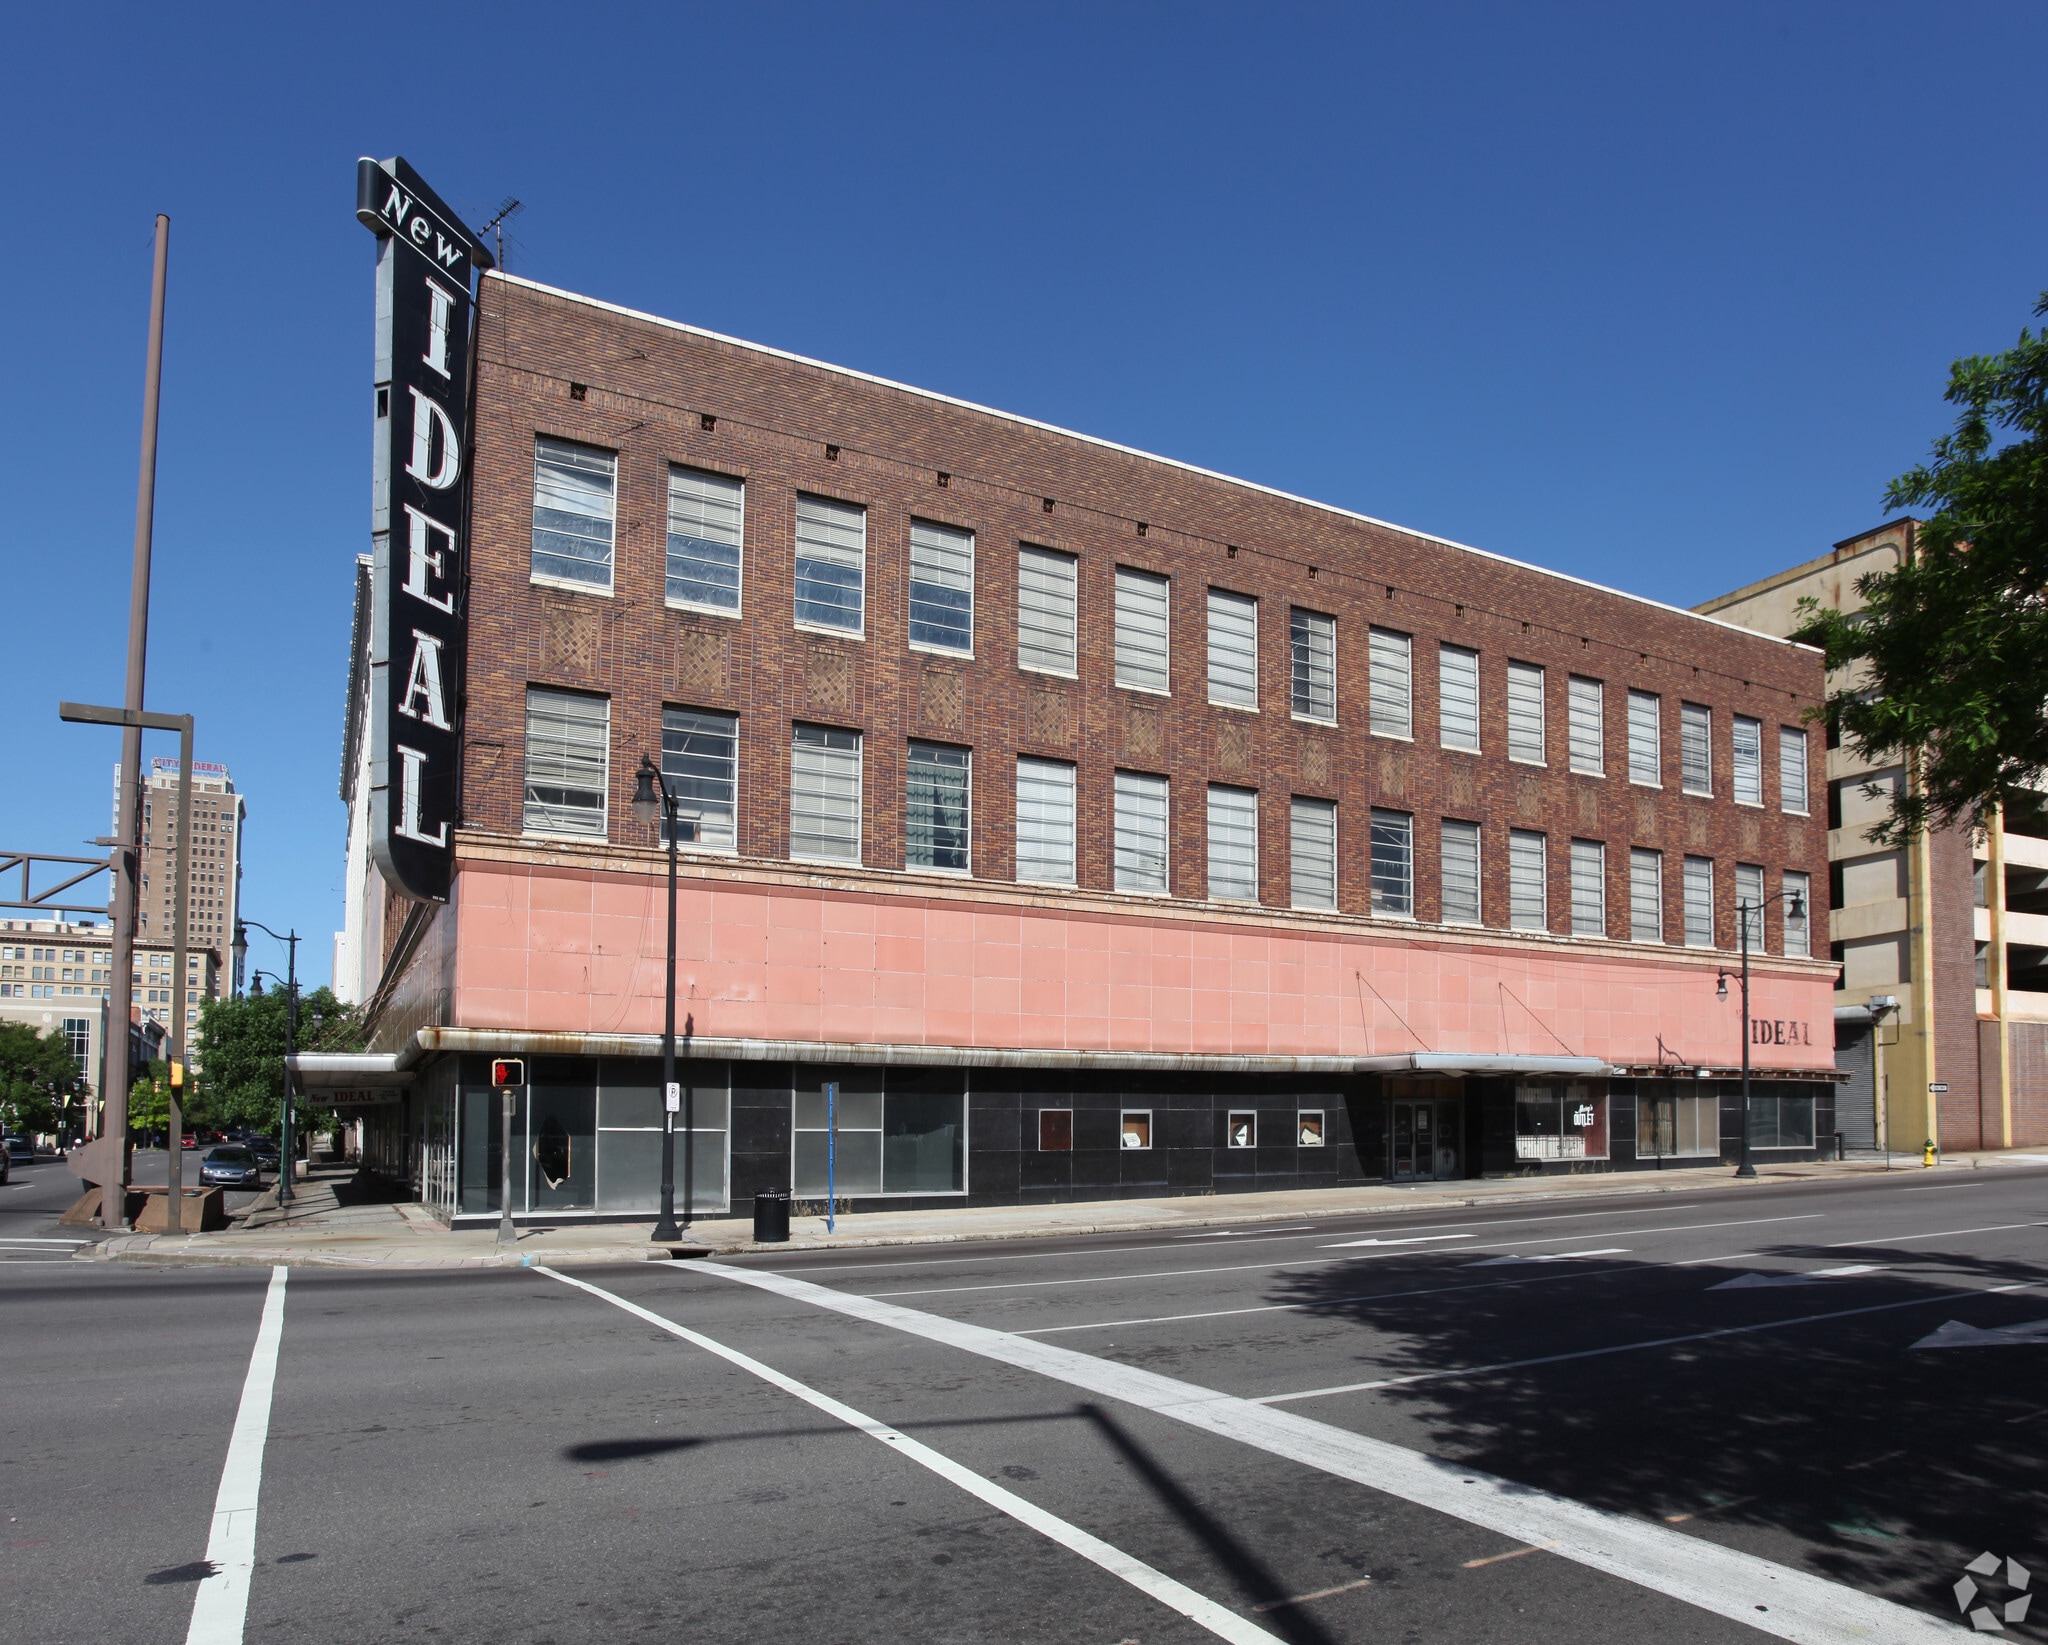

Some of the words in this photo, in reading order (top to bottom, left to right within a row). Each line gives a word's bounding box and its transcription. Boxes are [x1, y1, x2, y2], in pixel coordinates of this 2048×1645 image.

[381, 183, 463, 268] New
[395, 276, 463, 848] IDEAL
[154, 757, 179, 768] CITY
[191, 761, 224, 773] DERAL
[309, 1093, 329, 1103] New
[334, 1090, 375, 1103] IDEAL
[1573, 1113, 1595, 1127] OUTLET
